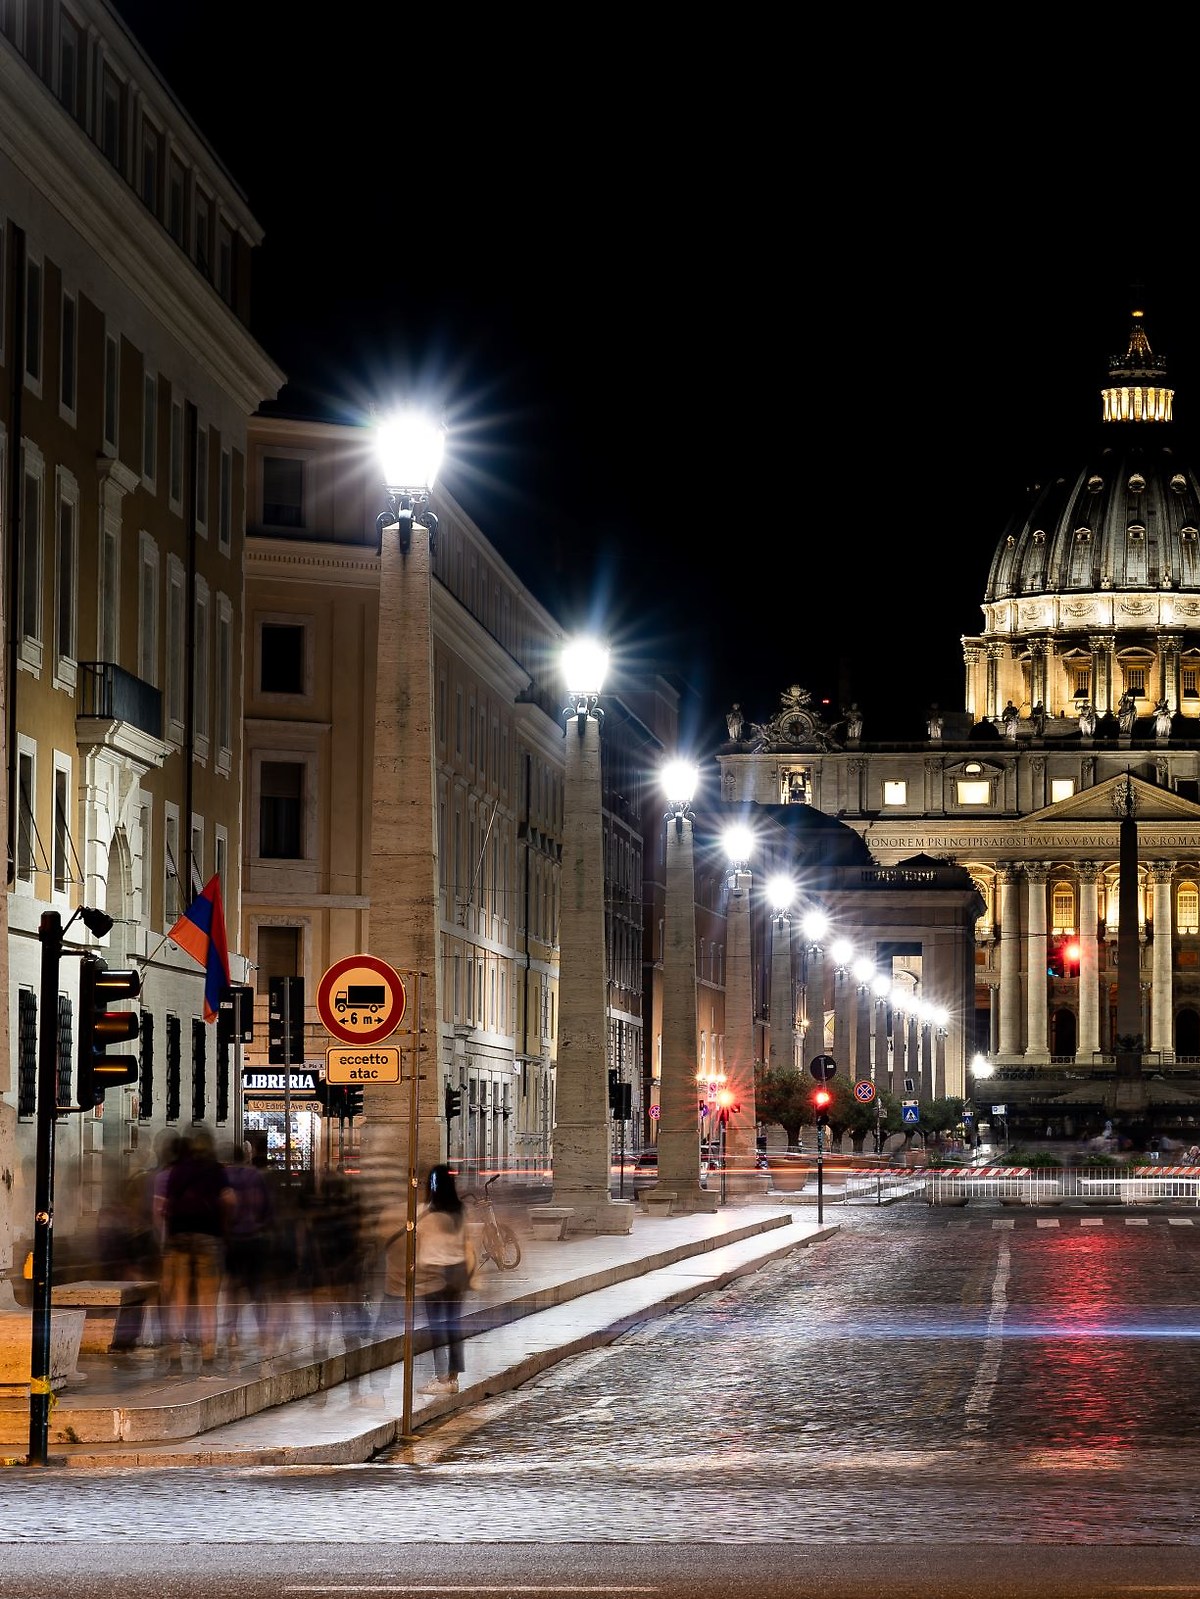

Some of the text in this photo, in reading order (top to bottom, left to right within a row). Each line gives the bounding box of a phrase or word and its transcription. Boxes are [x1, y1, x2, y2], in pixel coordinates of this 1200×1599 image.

[350, 1012, 373, 1025] 6 m
[340, 1053, 389, 1065] eccetto
[350, 1067, 379, 1079] atac
[243, 1074, 316, 1089] LIBRERIA
[266, 1103, 289, 1112] Editric
